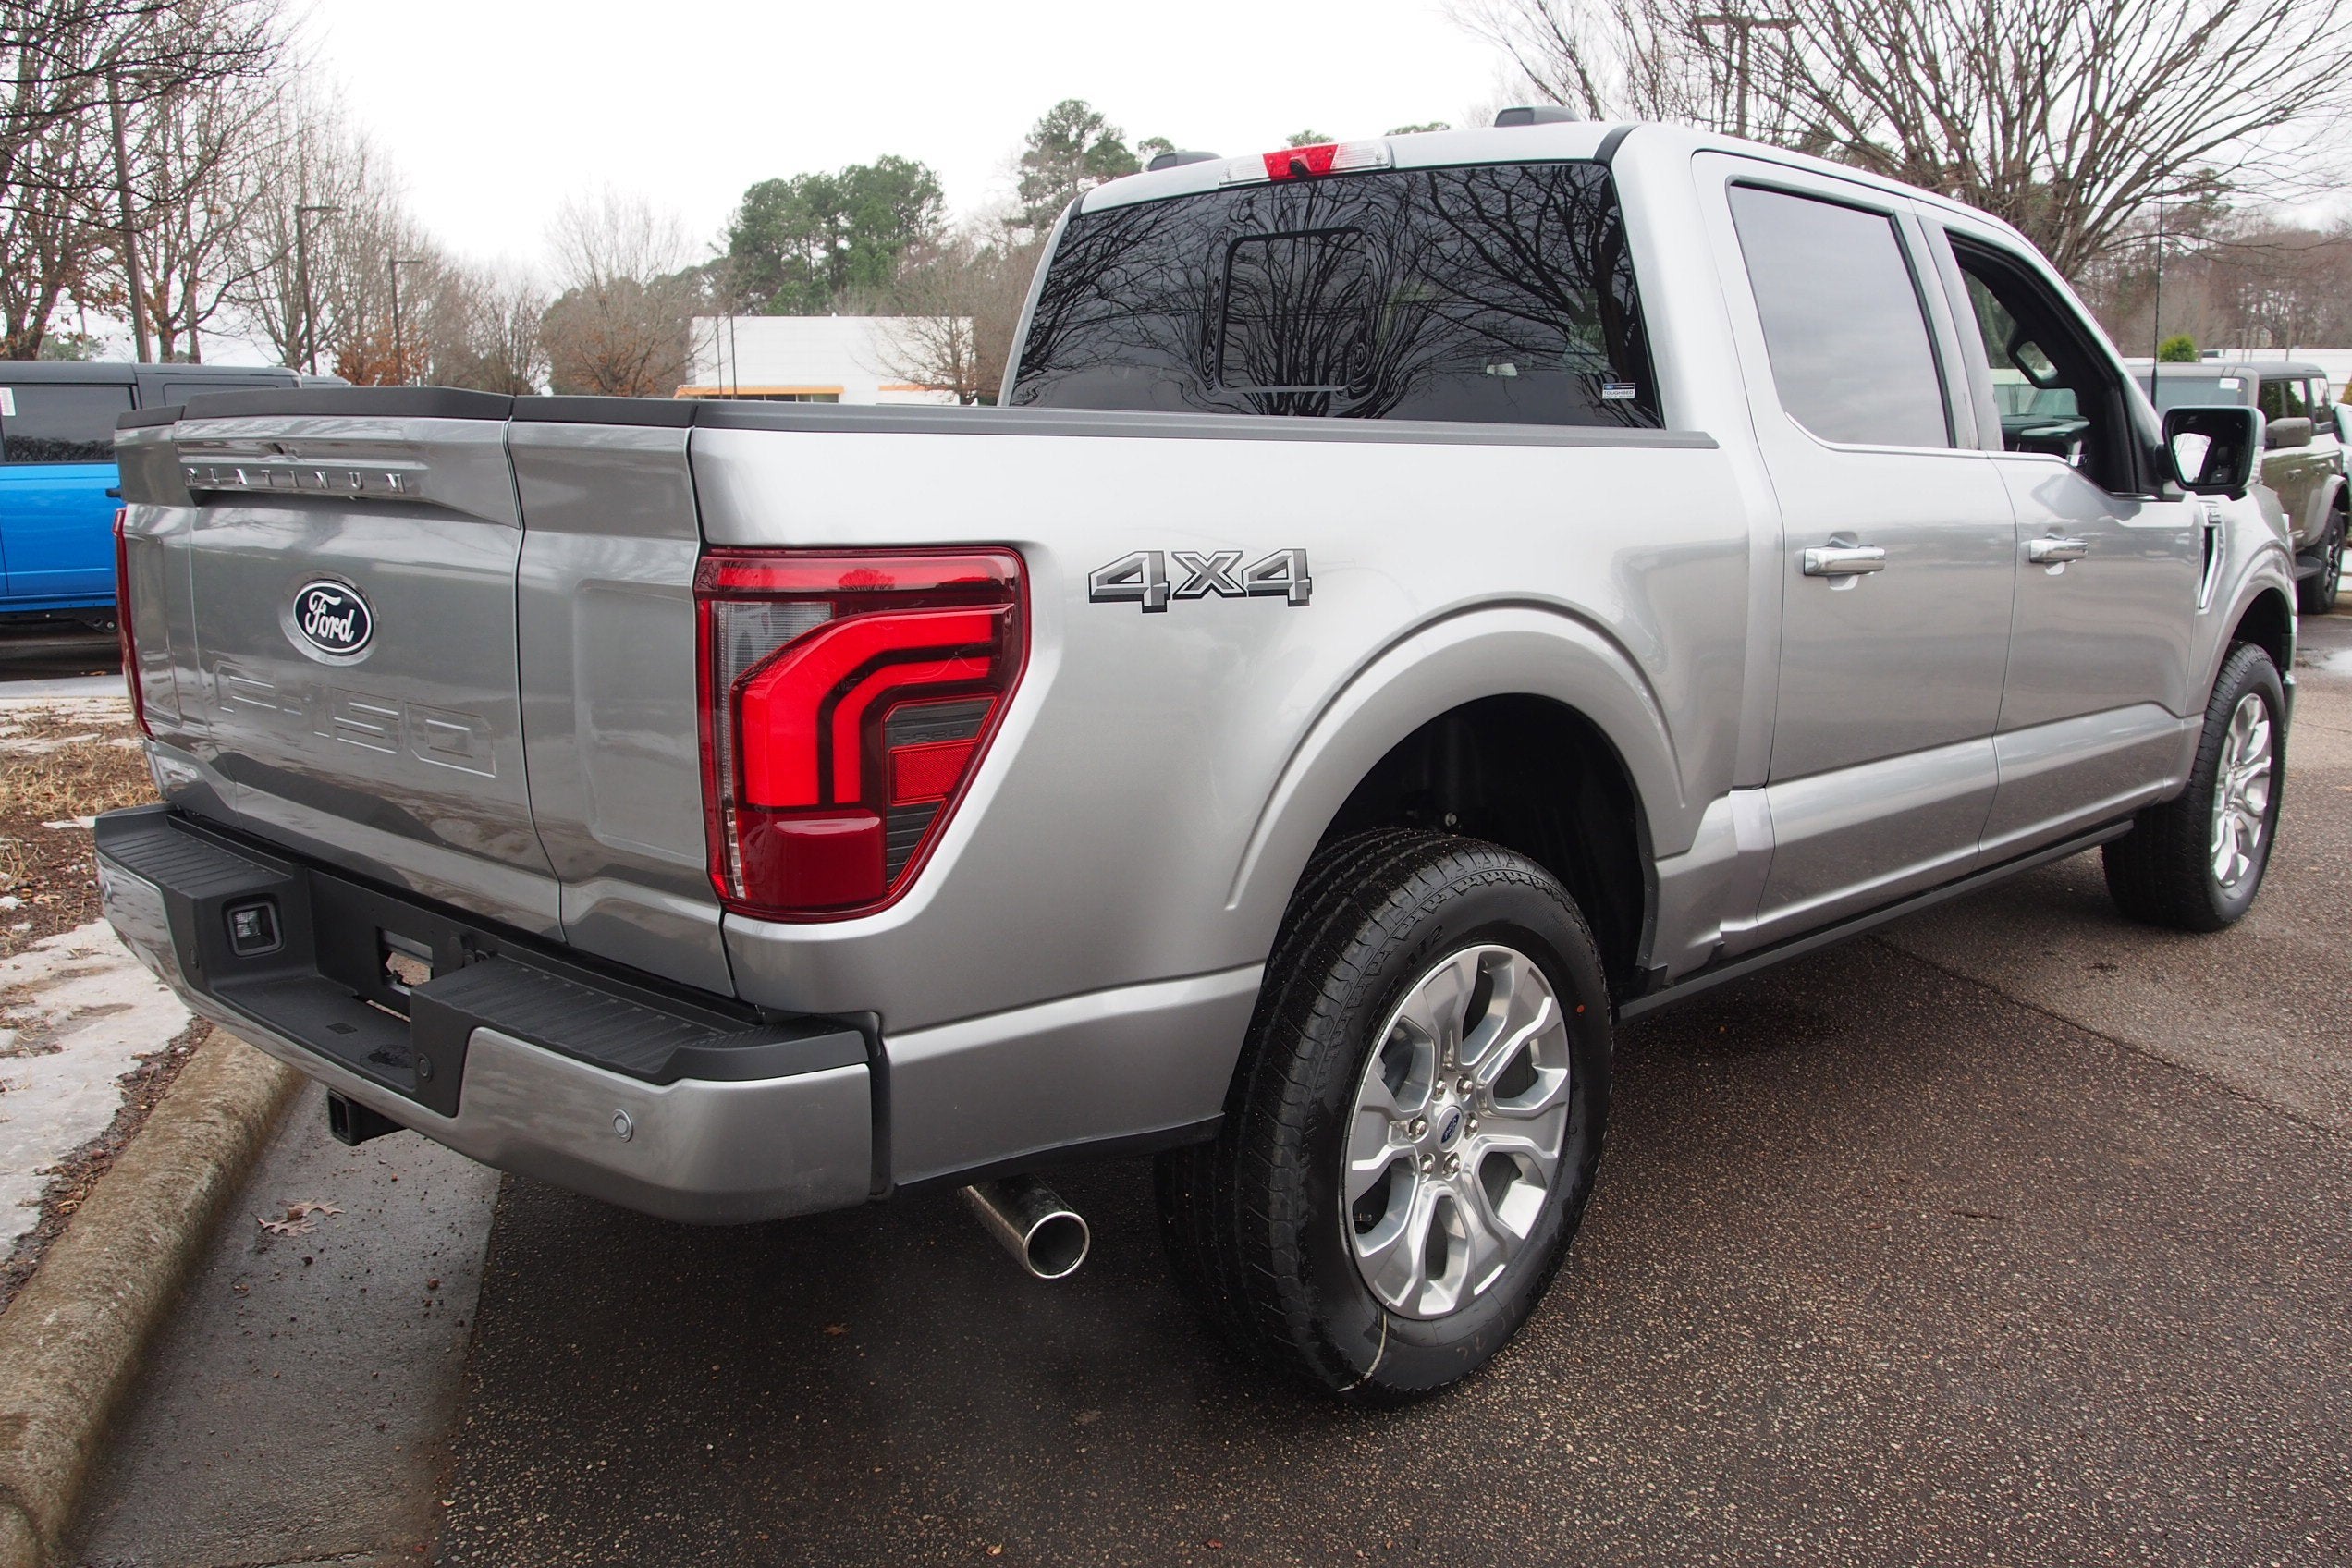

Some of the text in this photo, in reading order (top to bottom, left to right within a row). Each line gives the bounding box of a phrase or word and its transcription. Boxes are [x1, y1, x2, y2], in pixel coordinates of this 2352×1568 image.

[188, 467, 406, 493] PLATINUM
[304, 590, 355, 643] Ford
[215, 660, 497, 778] F-150
